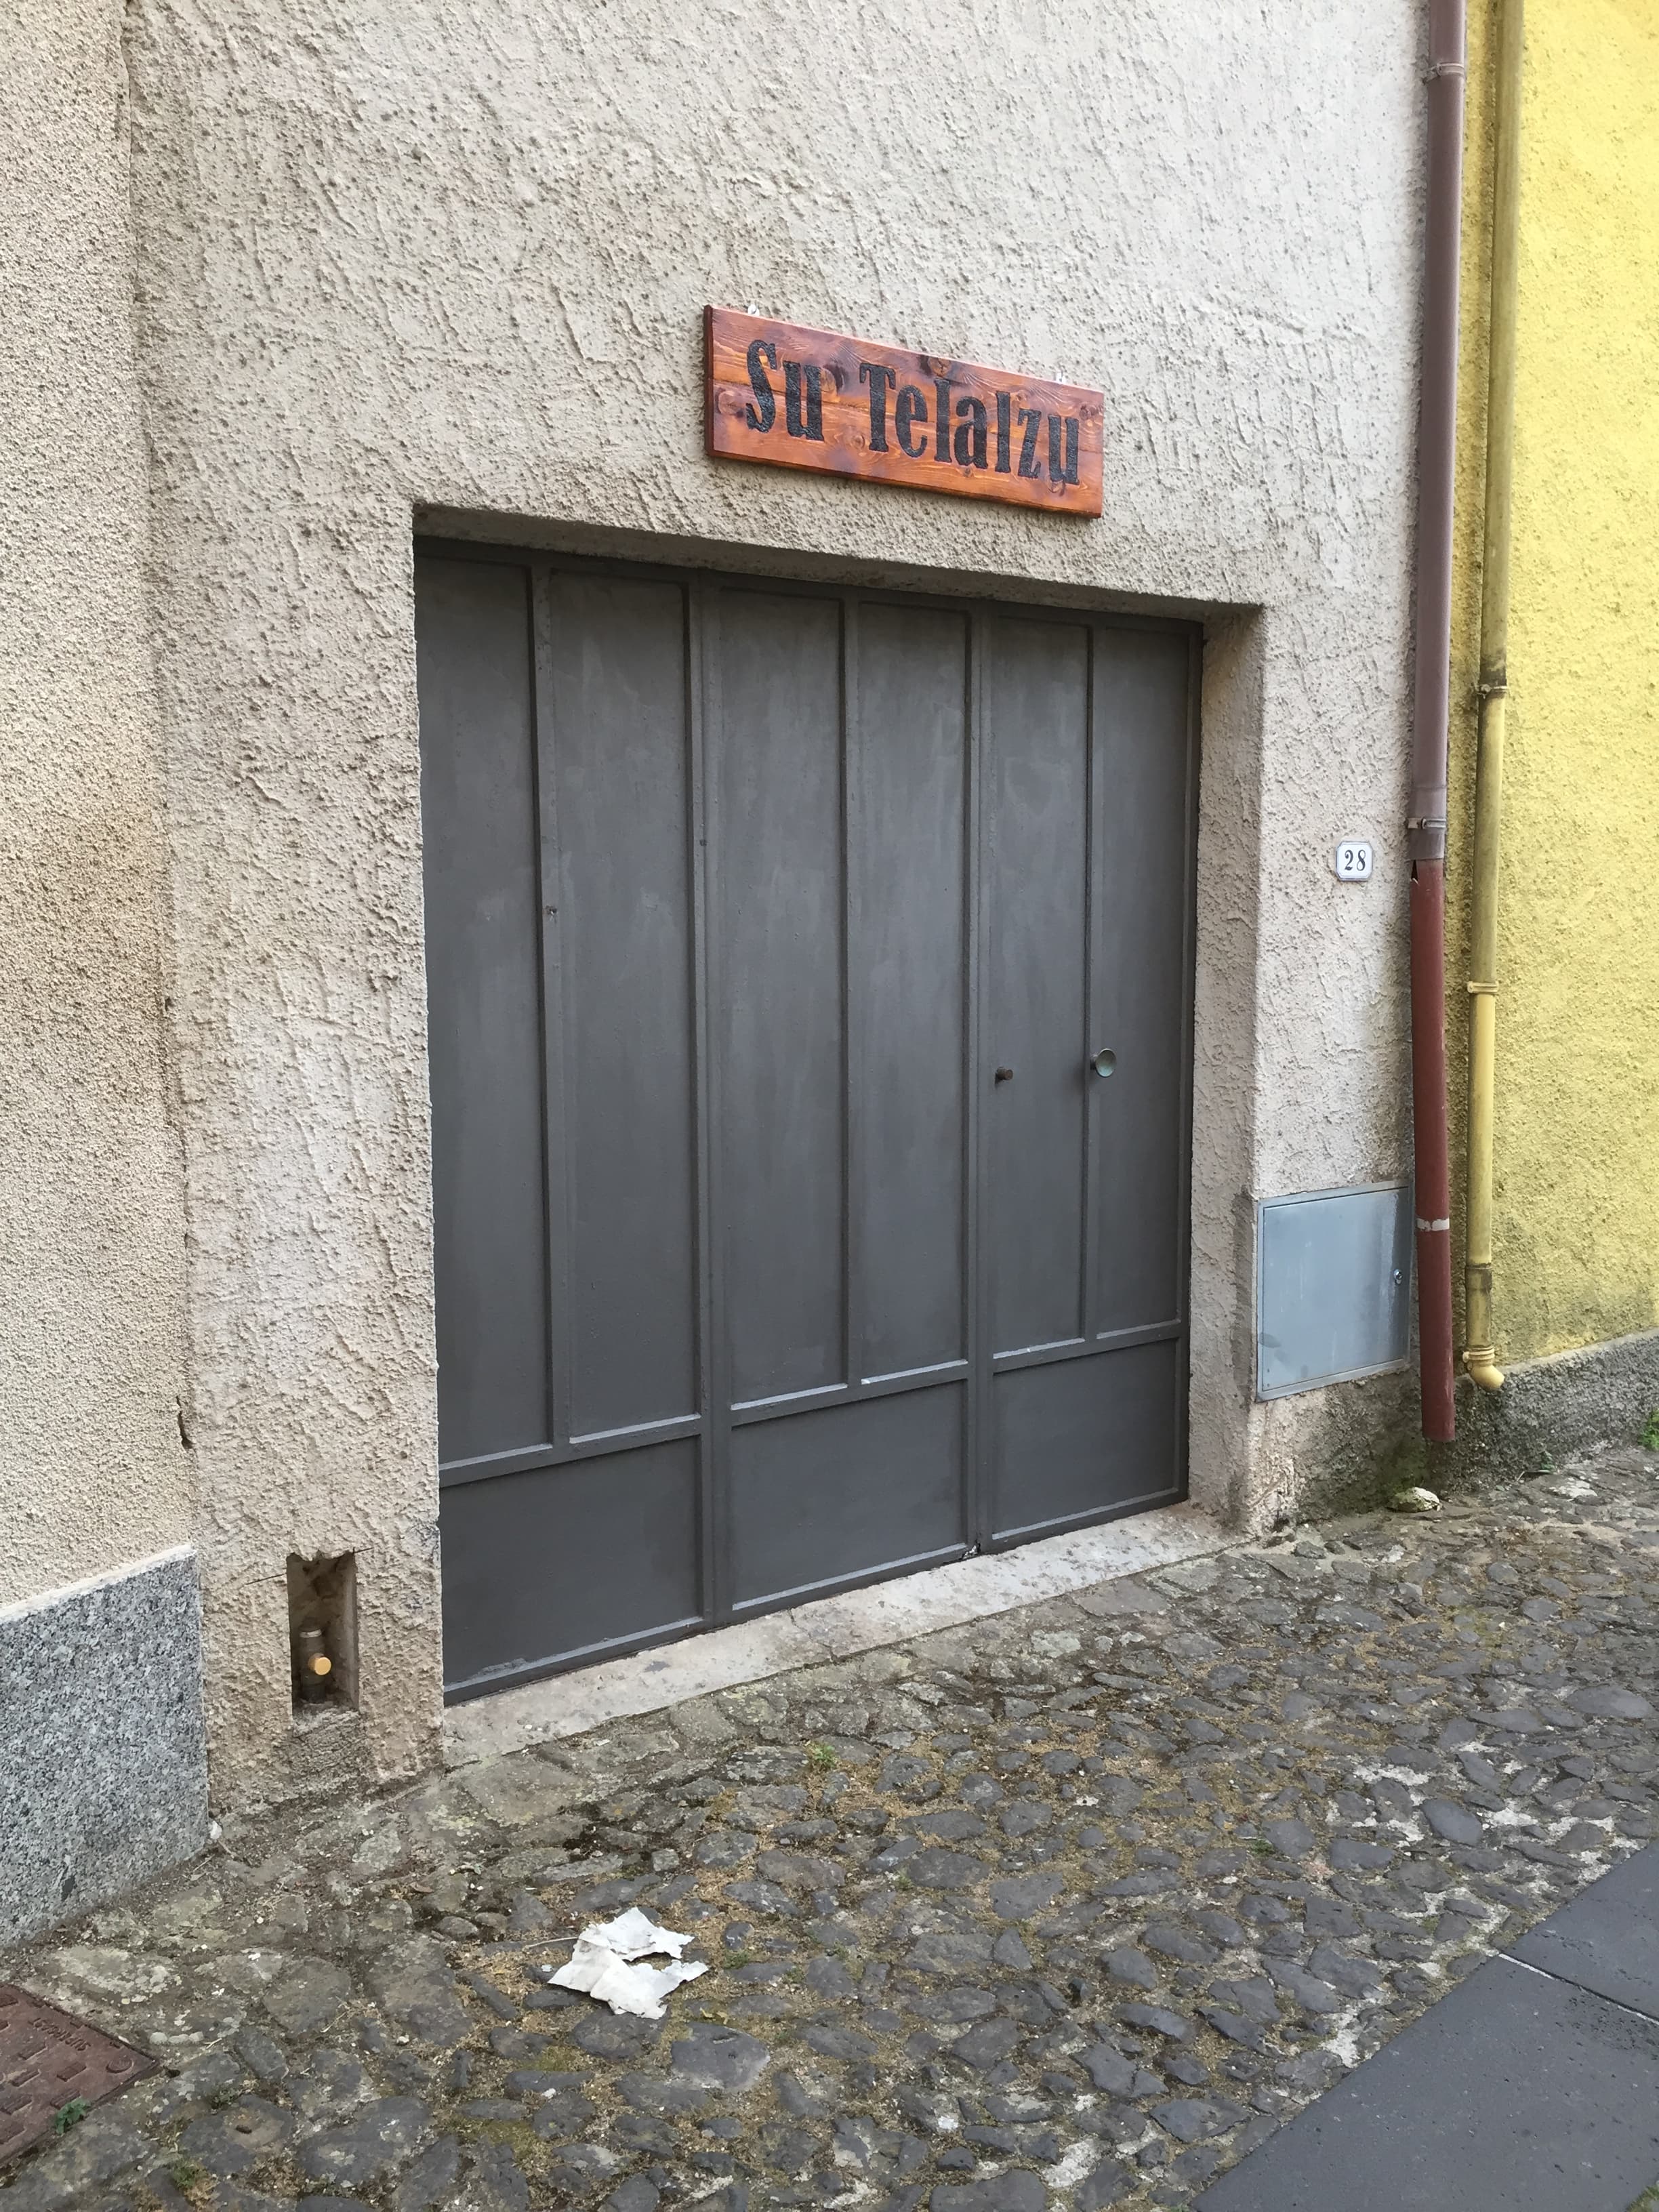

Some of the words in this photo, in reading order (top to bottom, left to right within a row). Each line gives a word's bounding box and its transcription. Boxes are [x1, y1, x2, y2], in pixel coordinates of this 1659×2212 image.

[747, 339, 824, 441] Su
[859, 363, 1080, 486] Telalzu
[1344, 849, 1366, 872] 28
